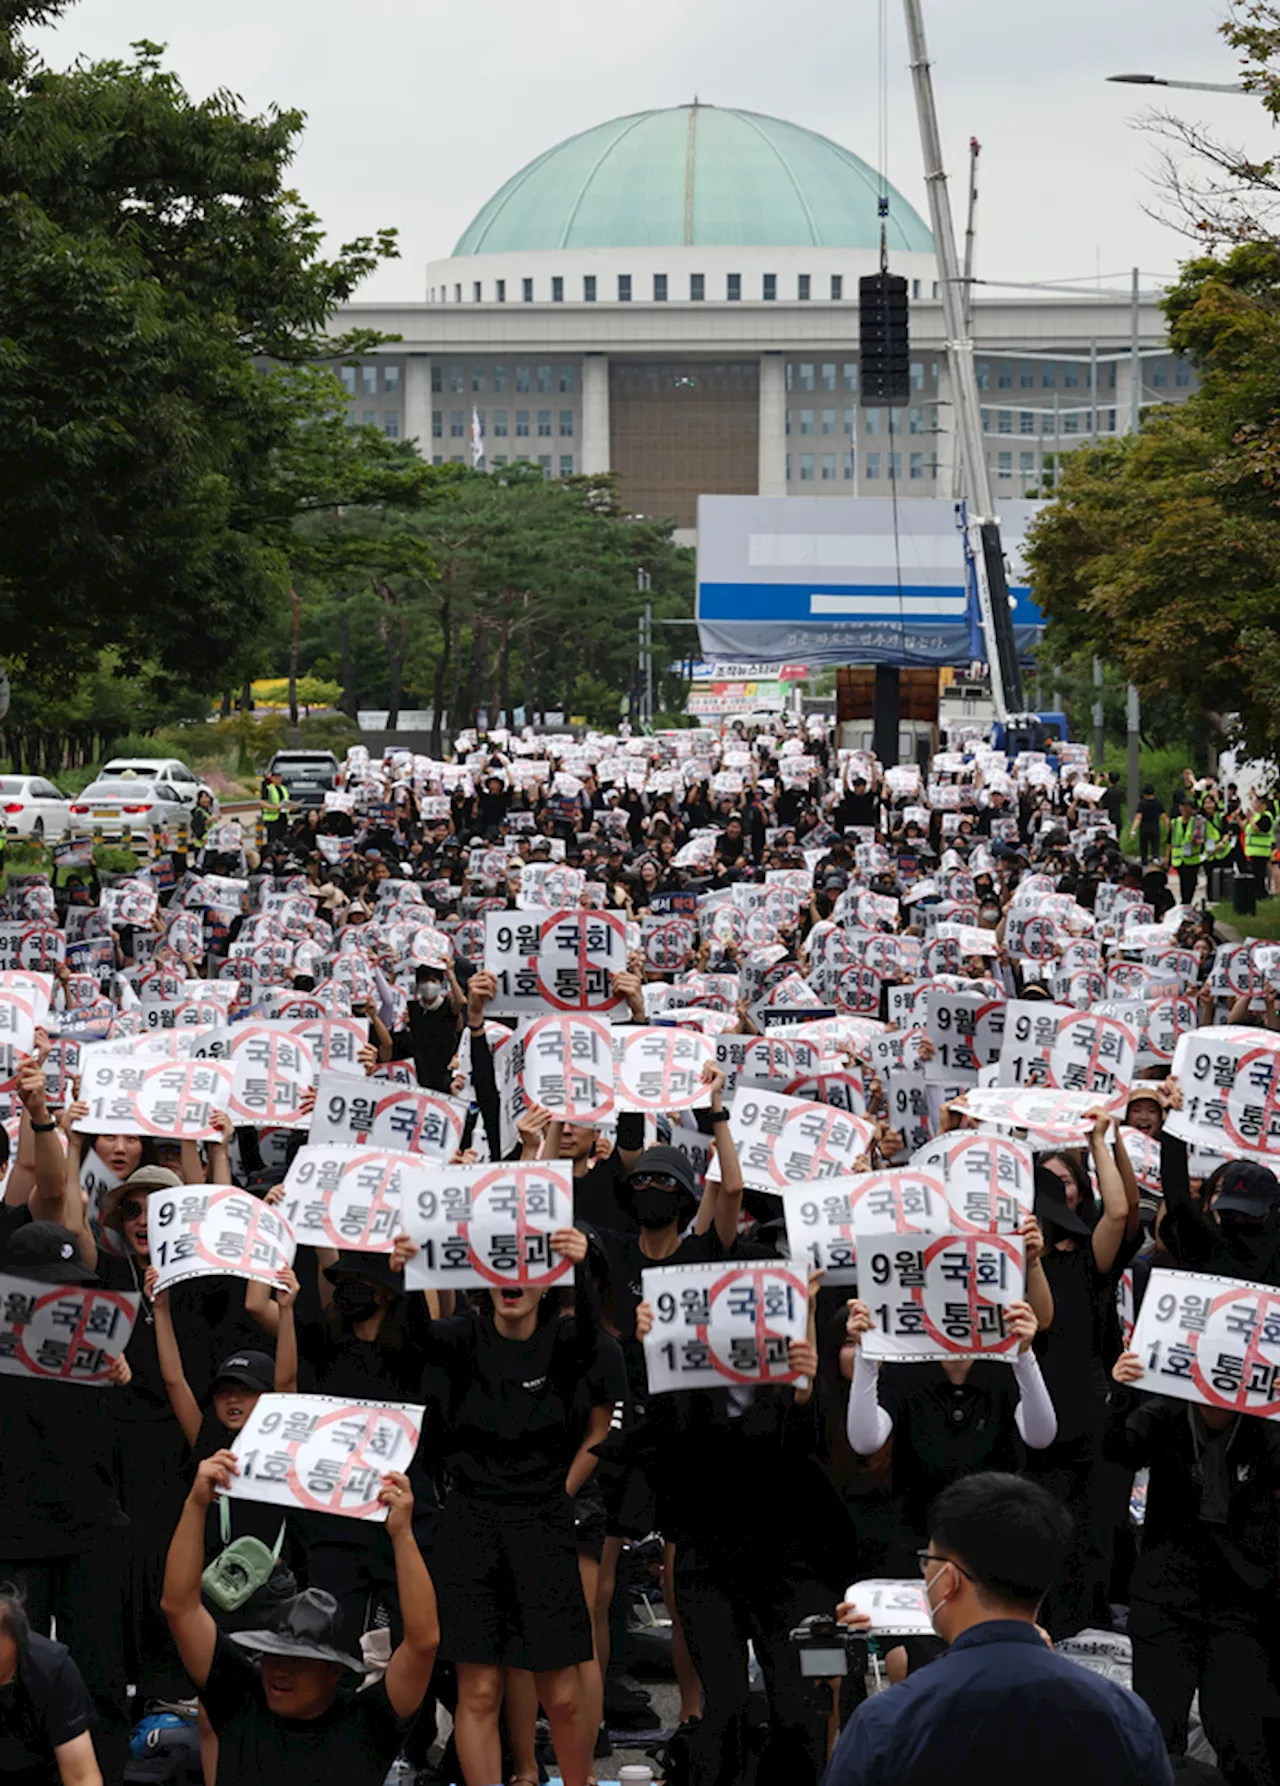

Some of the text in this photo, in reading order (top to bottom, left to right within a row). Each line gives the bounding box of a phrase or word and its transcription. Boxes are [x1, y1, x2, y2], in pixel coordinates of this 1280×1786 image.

[860, 633, 898, 646] 멈추지
[523, 869, 581, 887] 9월 국회
[524, 890, 577, 907] 1호 통과
[749, 893, 794, 907] 9월 국회
[462, 927, 484, 939] 국회
[953, 913, 974, 926] 국회
[1009, 920, 1054, 936] 9월 국회
[0, 936, 58, 952] 9월 국회
[235, 946, 286, 959] 9월 국회
[497, 925, 612, 956] 9월 국회
[655, 934, 678, 947] 국회
[936, 943, 957, 956] 국회
[1008, 939, 1022, 951] 1호
[1074, 946, 1097, 961] 국회
[0, 959, 19, 970] 1호
[225, 964, 252, 978] 국회
[260, 964, 283, 977] 통과
[315, 959, 366, 977] 9월 국회
[745, 968, 762, 983] 9월
[826, 968, 875, 987] 9월 국회
[1166, 956, 1193, 975] 국회
[149, 978, 178, 995] 국회
[498, 968, 612, 999] 1호 통과
[1078, 977, 1101, 995] 국회
[1211, 973, 1265, 989] 1호 통과
[846, 991, 874, 1005] 통과
[894, 992, 915, 1008] 9월
[148, 1009, 217, 1028] 9월 국회
[937, 1007, 977, 1036] 9월
[1158, 1006, 1192, 1026] 국회
[303, 1033, 354, 1062] 국회
[537, 1030, 597, 1063] 국회
[641, 1036, 700, 1063] 국회
[878, 1040, 904, 1057] 9월
[1015, 1015, 1060, 1048] 9월
[1071, 1023, 1124, 1064] 국회
[48, 1047, 79, 1067] 국회
[246, 1039, 300, 1072] 국회
[716, 1043, 788, 1067] 9월 국회
[938, 1044, 975, 1069] 1호
[96, 1068, 217, 1094] 9월 국회
[636, 1070, 699, 1098] 통과
[1012, 1056, 1049, 1086] 1호
[1062, 1062, 1116, 1095] 통과
[1193, 1054, 1239, 1089] 9월
[242, 1079, 300, 1110] 통과
[537, 1075, 598, 1108] 통과
[897, 1089, 928, 1115] 9월
[92, 1097, 211, 1127] 1호 통과
[327, 1096, 448, 1148] 9월 국회
[1188, 1096, 1228, 1128] 1호
[740, 1102, 857, 1152] 9월 국회
[898, 1125, 929, 1150] 1호
[296, 1161, 345, 1190] 9월
[785, 1151, 843, 1181] 통과
[965, 1150, 1019, 1188] 국회
[417, 1183, 554, 1221] 9월 국회
[800, 1185, 932, 1226] 9월 국회
[964, 1192, 1018, 1229] 통과
[159, 1196, 284, 1244] 9월 국회
[287, 1200, 400, 1238] 1호 통과
[157, 1231, 278, 1268] 1호 통과
[420, 1233, 553, 1270] 1호 통과
[807, 1237, 856, 1271] 1호
[871, 1250, 1006, 1289] 9월 국회
[0, 1291, 120, 1339] 월 국회
[657, 1285, 794, 1325] 9월 국회
[1155, 1293, 1213, 1333] 9월
[875, 1301, 1005, 1338] 1호 통과
[37, 1339, 106, 1373] 통과
[661, 1339, 713, 1371] 1호
[1147, 1340, 1279, 1402] 1호 통과
[258, 1411, 403, 1461] 9월 국회
[243, 1449, 380, 1501] 1호 통과
[868, 1590, 923, 1611] 1호
